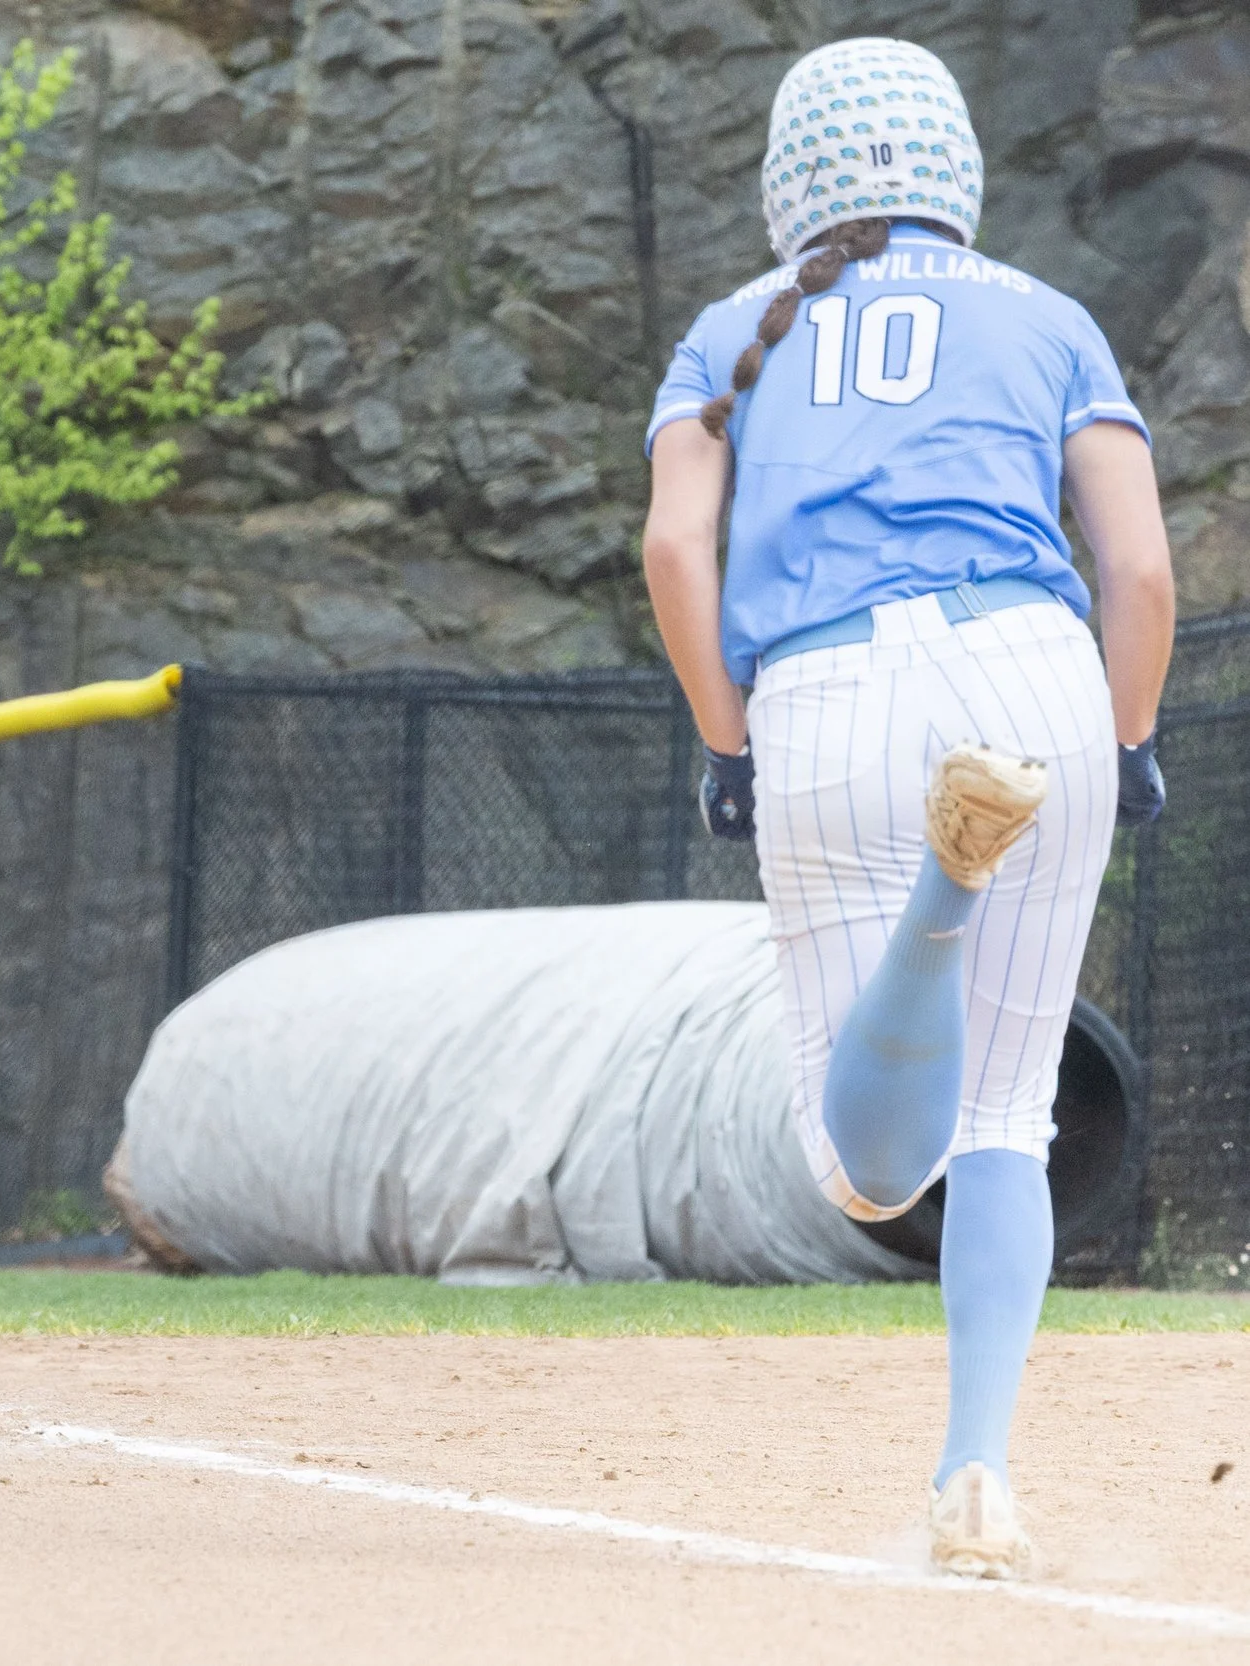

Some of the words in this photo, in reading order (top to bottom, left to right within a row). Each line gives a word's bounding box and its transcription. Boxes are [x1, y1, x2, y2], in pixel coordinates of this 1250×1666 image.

[869, 142, 893, 168] 10
[857, 251, 1033, 295] WILLIAMS
[806, 293, 944, 406] 10
